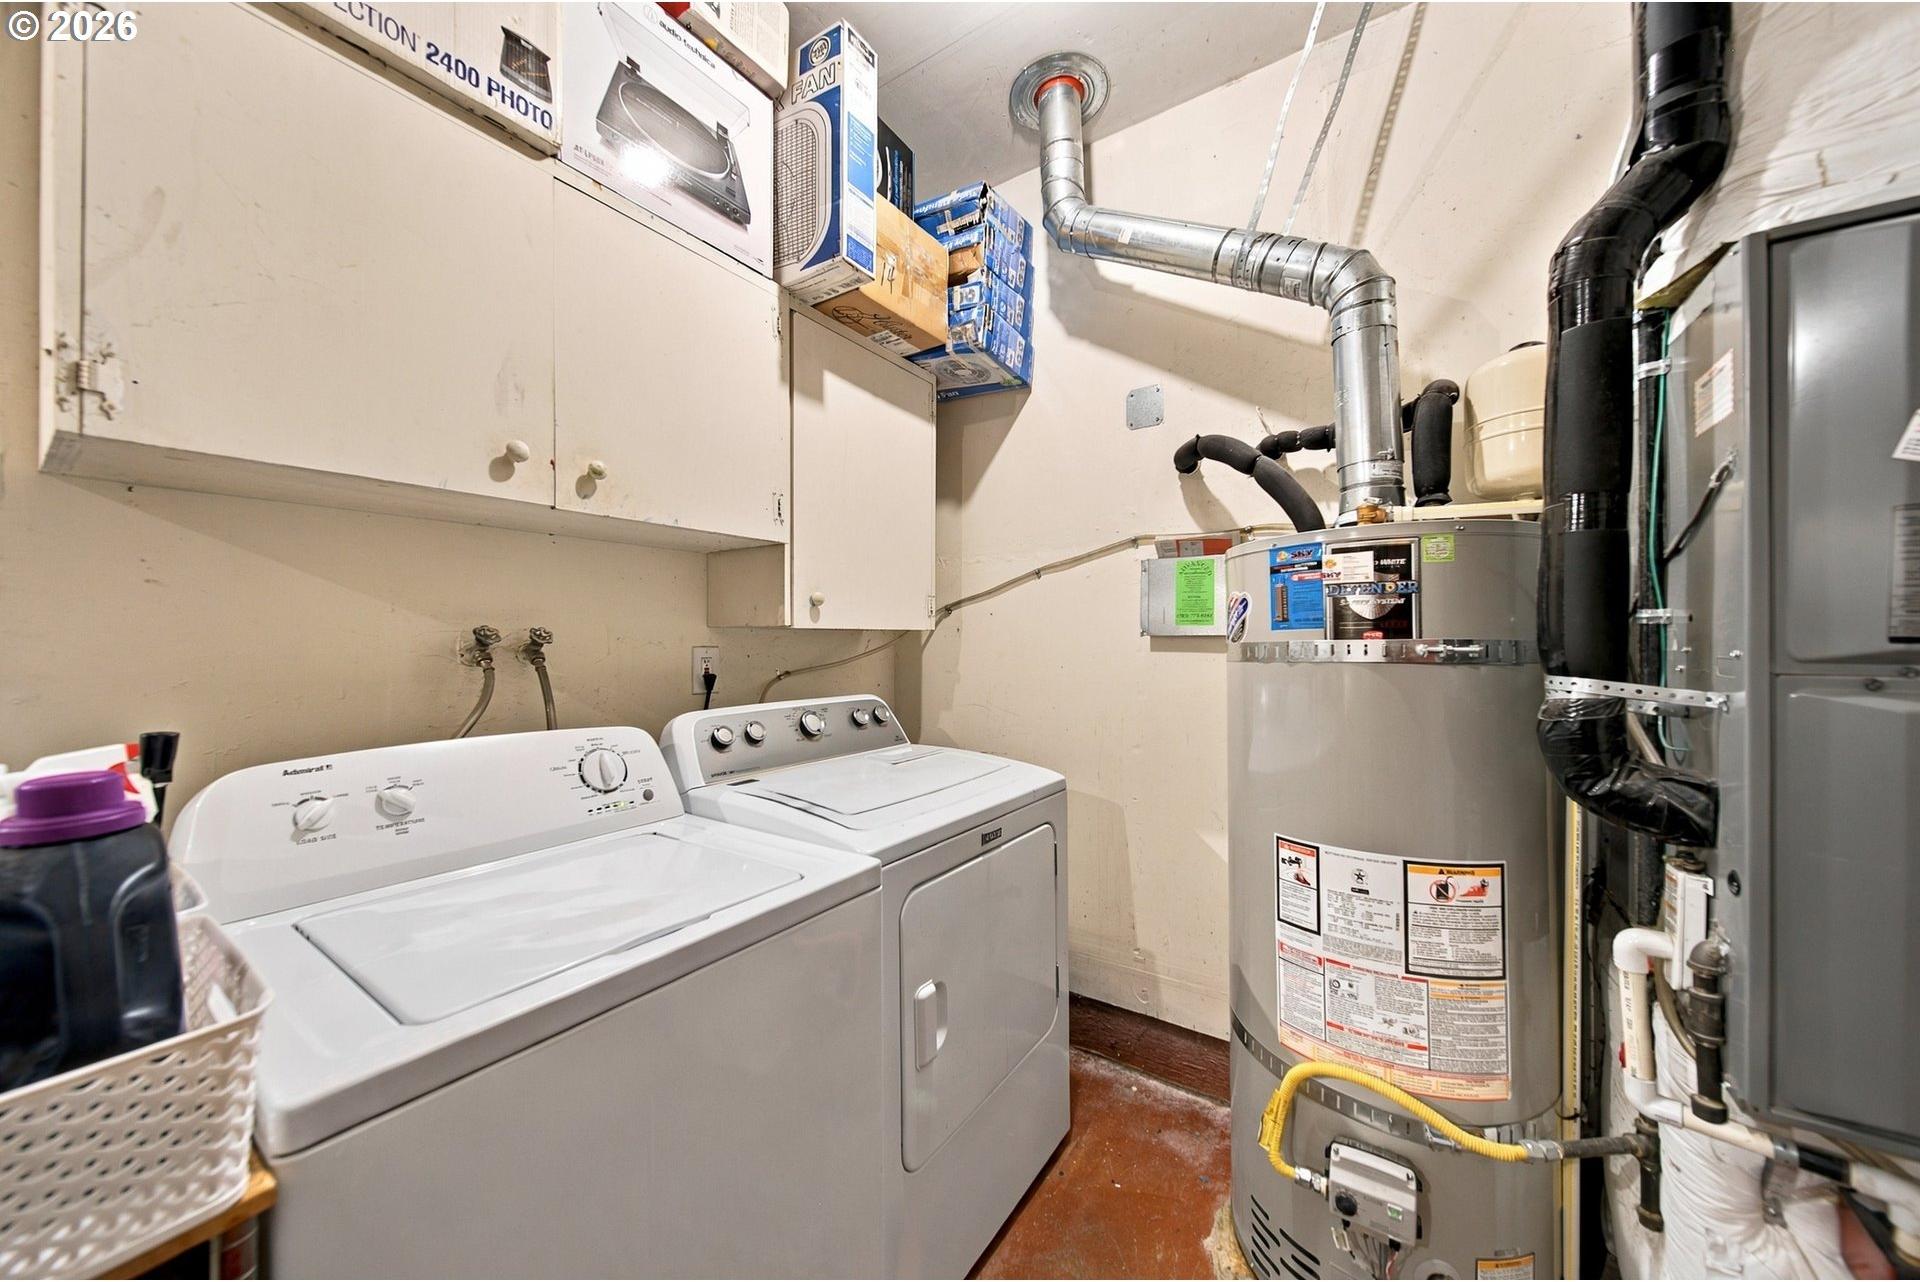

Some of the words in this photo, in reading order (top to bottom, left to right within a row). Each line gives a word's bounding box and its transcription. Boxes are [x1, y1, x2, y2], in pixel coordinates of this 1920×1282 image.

[425, 41, 481, 88] 2400
[486, 77, 552, 131] PHOTO
[791, 62, 836, 105] FAN
[1327, 580, 1419, 597] DEFENDER
